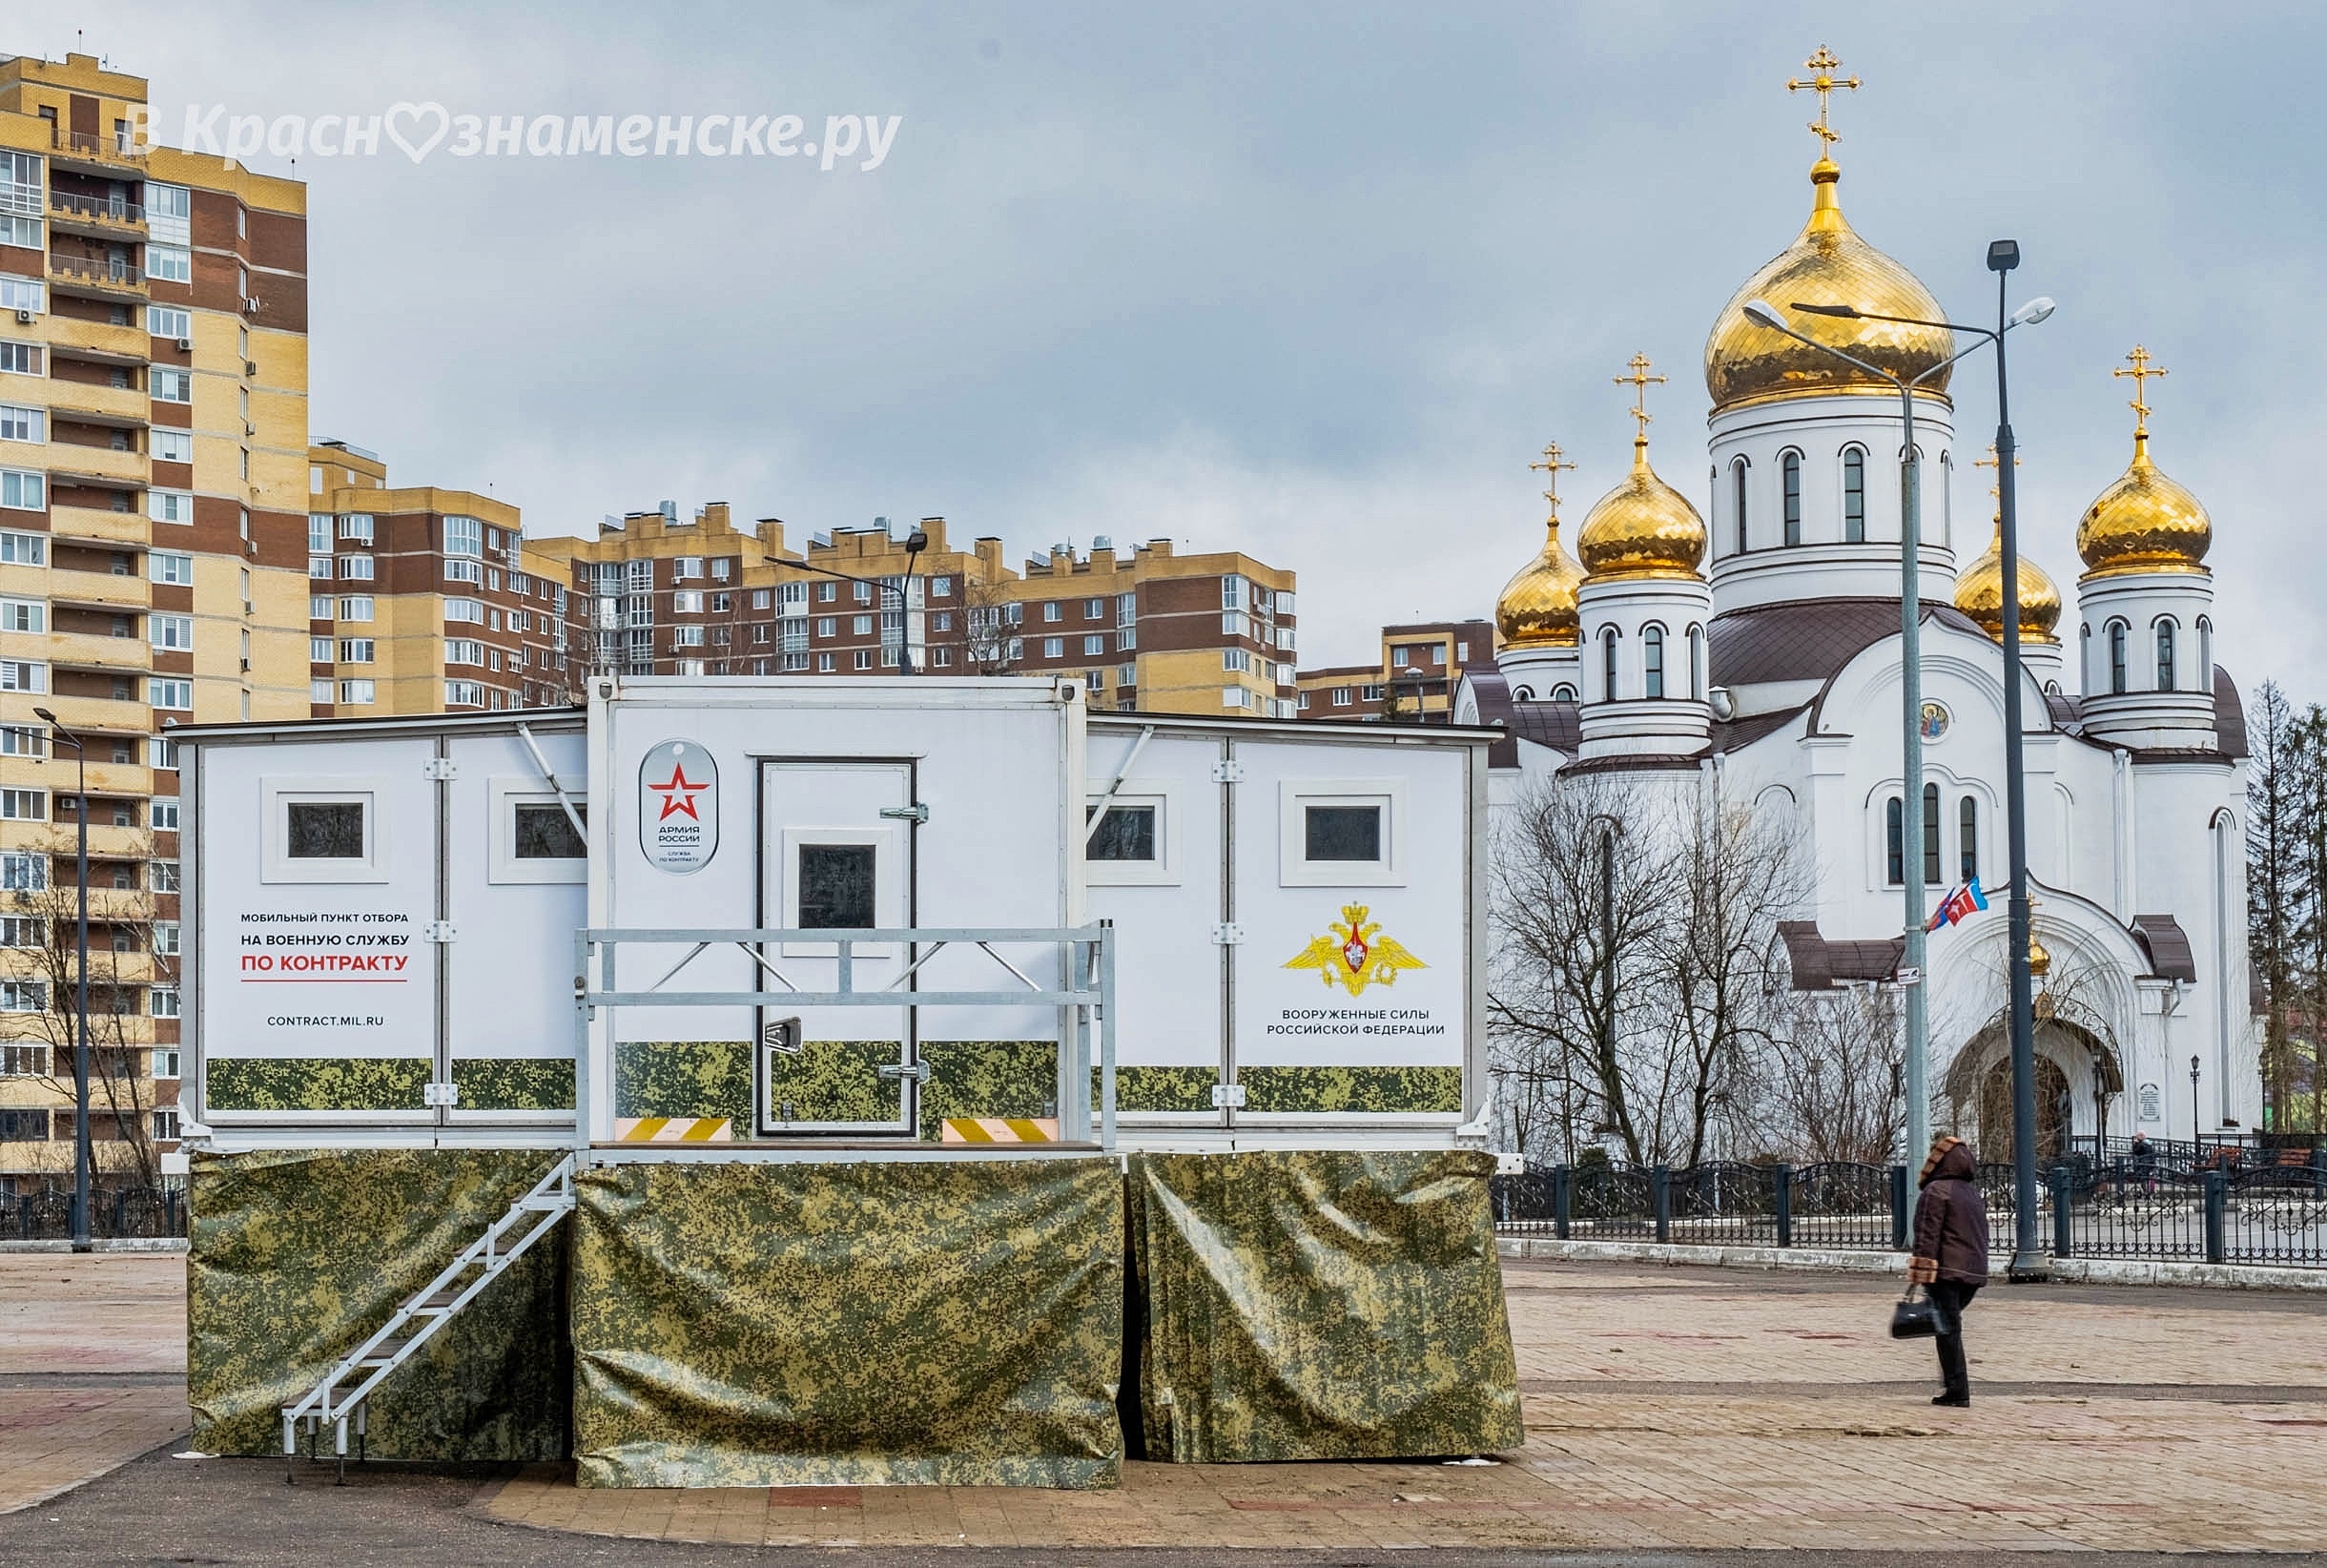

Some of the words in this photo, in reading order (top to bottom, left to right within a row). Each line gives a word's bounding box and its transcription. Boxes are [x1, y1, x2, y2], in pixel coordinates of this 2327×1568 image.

[659, 835, 700, 843] РОССИИ
[240, 913, 318, 922] МОБИЛЬНЫЙ
[320, 914, 360, 922] ПУНКТ
[362, 914, 409, 922] ОТБОРА
[240, 935, 262, 946] НА
[266, 935, 342, 946] ВОЕННУЮ
[345, 935, 410, 946] СЛУЖБУ
[241, 956, 274, 971] ПО
[280, 956, 409, 971] КОНТРАКТУ
[1282, 1010, 1387, 1020] ВООРУЖЕННЫЕ
[1390, 1010, 1430, 1020] СИЛЫ
[267, 1016, 384, 1026] CONTRACT.MIL.RU
[1266, 1023, 1359, 1035] РОССИЙСКОЙ
[1362, 1024, 1445, 1037] ФЕДЕРАЦИИ
